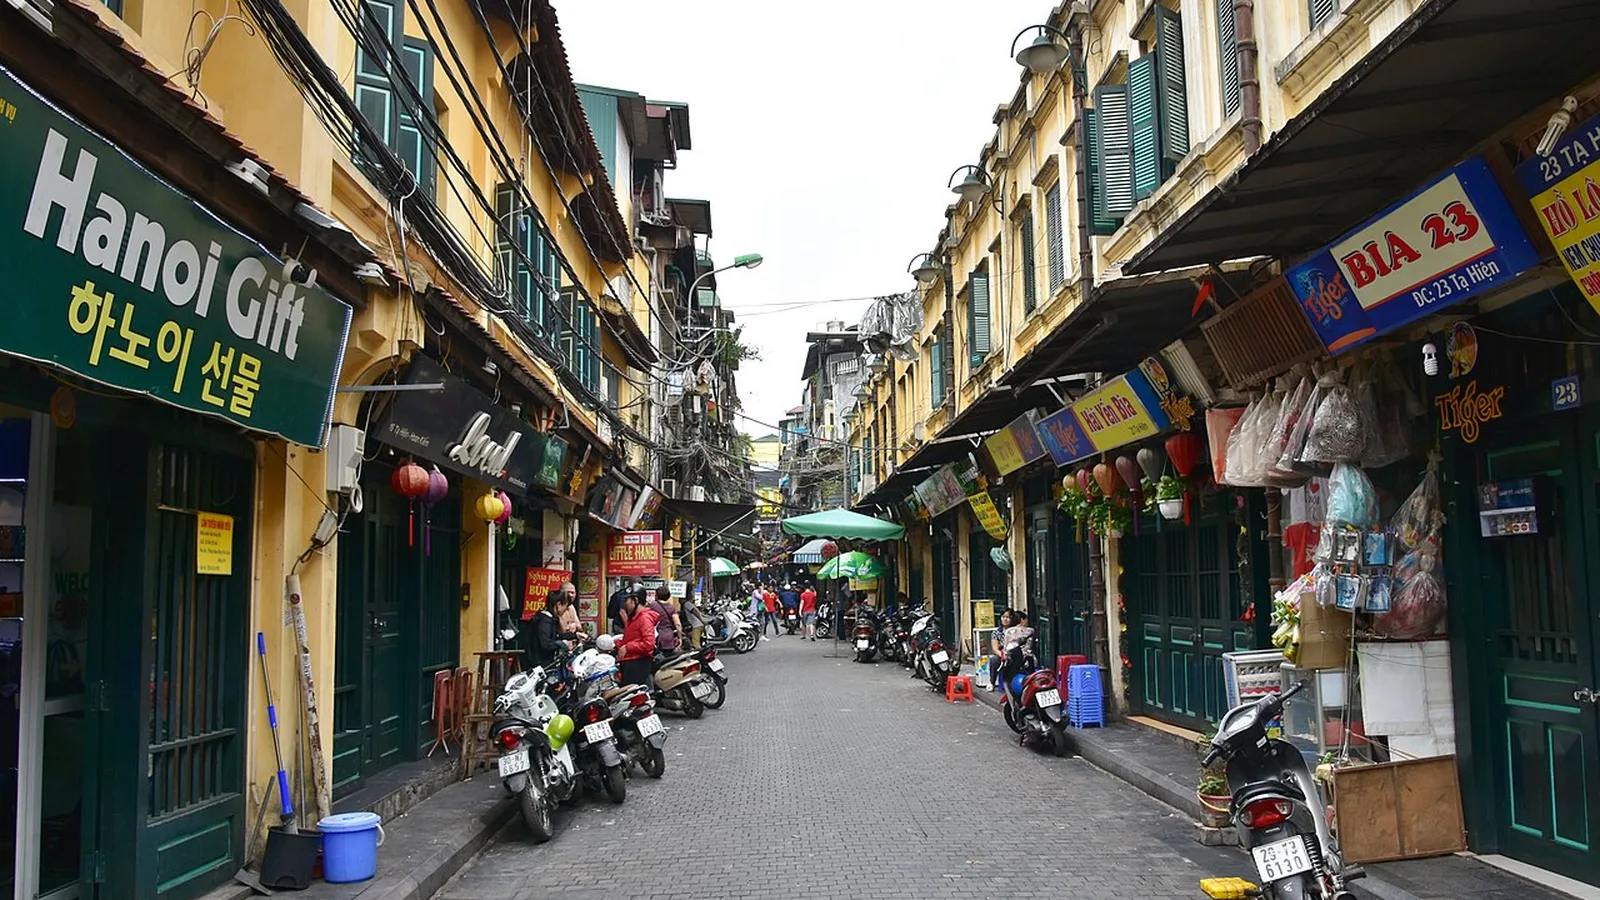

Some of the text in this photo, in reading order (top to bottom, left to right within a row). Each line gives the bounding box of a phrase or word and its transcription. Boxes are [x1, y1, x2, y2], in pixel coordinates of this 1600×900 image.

[1540, 156, 1562, 182] 23
[1560, 139, 1590, 167] TẠ
[1540, 188, 1579, 238] HỒ
[23, 127, 306, 360] Hanoi Gift
[1341, 201, 1480, 289] BIA 23
[1561, 243, 1590, 271] NEM
[1304, 271, 1347, 320] Tiger
[1432, 279, 1453, 299] 23
[1452, 273, 1470, 292] Tạ
[1469, 259, 1500, 284] Hiện
[68, 280, 262, 417] 하노이 선물
[1110, 394, 1138, 420] Bia
[1435, 380, 1506, 443] Tiger
[1555, 382, 1578, 406] 23
[529, 583, 549, 596] BÚN
[1266, 855, 1304, 878] 6130
